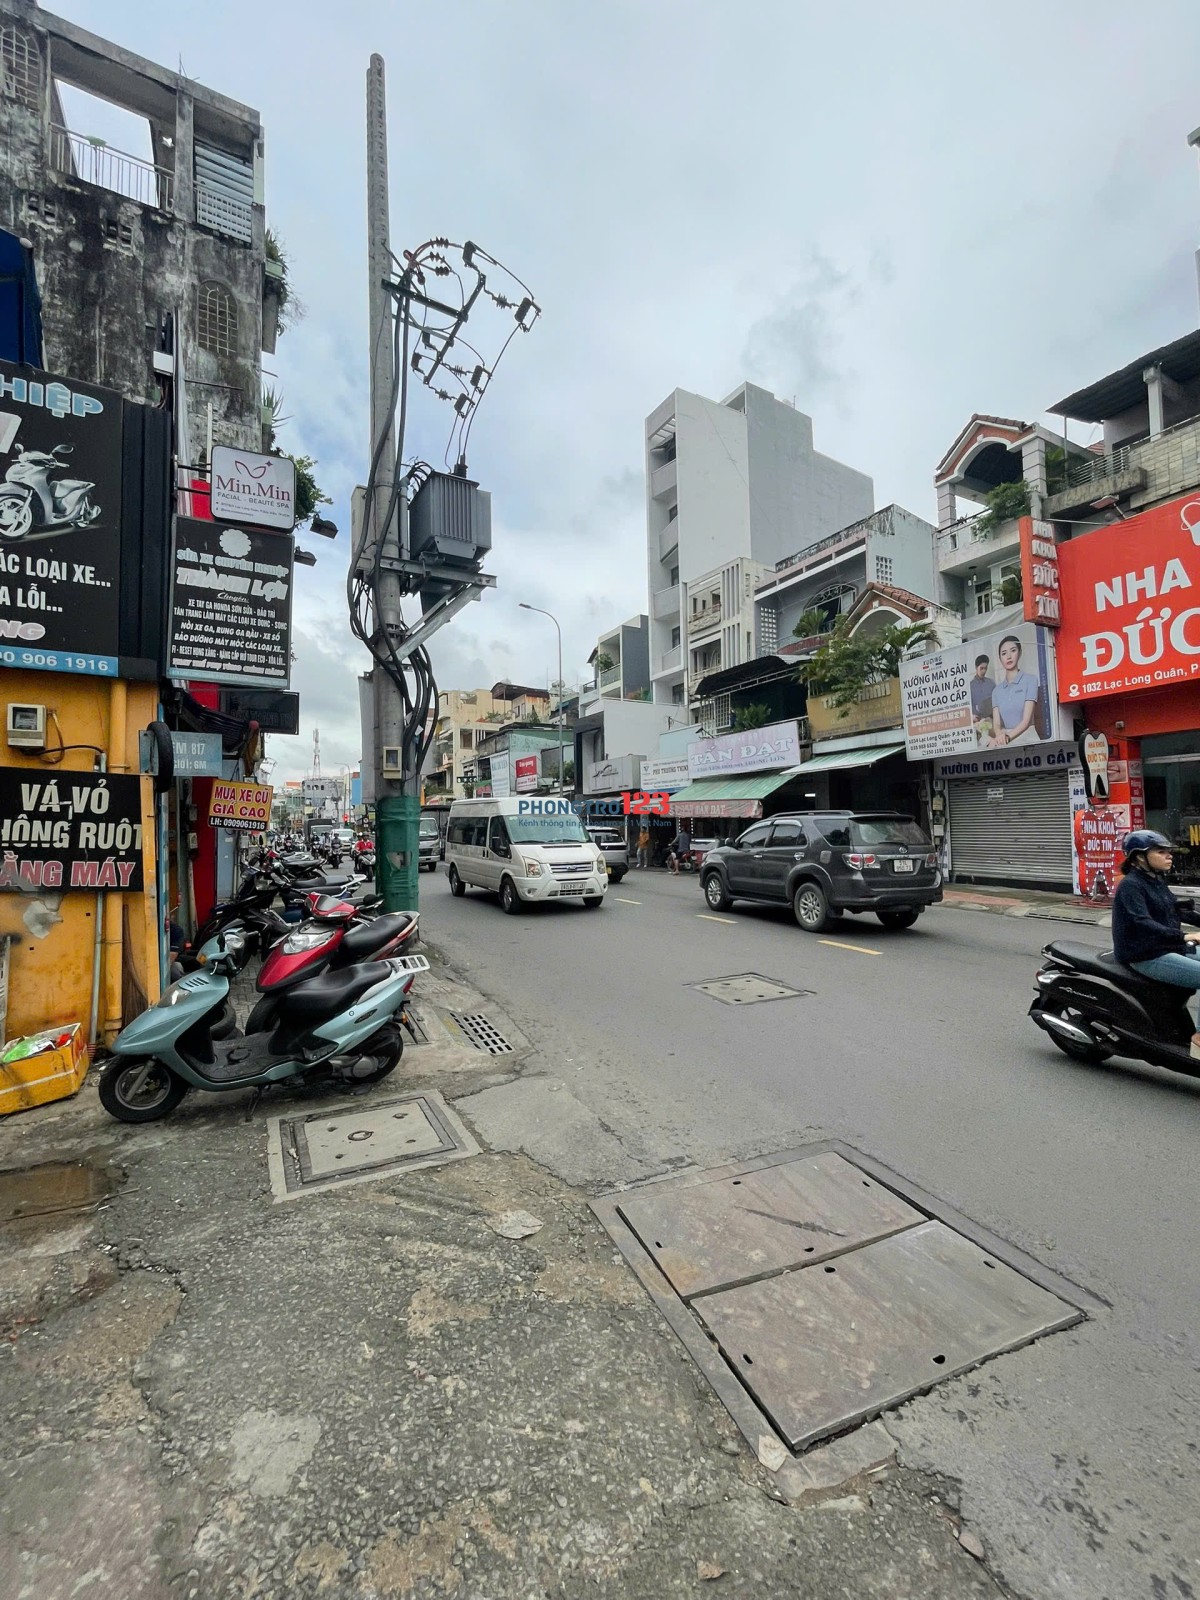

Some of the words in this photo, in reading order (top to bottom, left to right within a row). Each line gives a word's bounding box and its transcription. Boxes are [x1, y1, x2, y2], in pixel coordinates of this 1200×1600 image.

[215, 474, 291, 501] Min.Min
[217, 491, 242, 501] FACIAL
[248, 497, 275, 508] BEAUTÉ
[1032, 520, 1054, 540] NHA
[1031, 540, 1058, 560] KHOA
[25, 556, 67, 584] LOẠI
[72, 563, 111, 587] XE...
[1032, 560, 1059, 590] ĐỨC
[1094, 557, 1193, 613] NHA
[16, 582, 63, 612] LỖI...
[188, 599, 196, 607] XE
[196, 600, 205, 608] TAY
[205, 600, 213, 609] GA
[213, 601, 231, 612] HONDA
[1035, 591, 1059, 619] TÍN
[185, 608, 203, 618] TRANG
[250, 617, 257, 626] XE
[194, 623, 203, 631] XE
[216, 626, 234, 636] RUNG
[235, 629, 245, 637] GA
[262, 632, 271, 640] XE
[214, 636, 230, 646] MÁY
[22, 653, 58, 667] 906
[64, 657, 109, 671] 1916
[903, 674, 930, 689] XƯỞNG
[931, 669, 949, 681] MAY
[950, 663, 968, 676] SẢN
[1082, 681, 1102, 694] 1032
[1103, 679, 1123, 690] Lạc
[1124, 674, 1151, 687] Long
[907, 686, 928, 700] XUẤT
[929, 682, 940, 694] VÀ
[941, 681, 951, 692] IN
[952, 677, 965, 689] ÁO
[907, 699, 930, 711] THUN
[931, 695, 948, 706] CAO
[950, 689, 967, 702] CẤP
[191, 743, 206, 756] 817
[941, 762, 979, 775] XƯỞNG
[982, 759, 1011, 772] MAY
[1014, 755, 1042, 768] CAO
[1046, 749, 1077, 765] CẤP
[21, 779, 61, 812] VÁ
[71, 778, 110, 814] VỎ
[214, 786, 236, 801] MUA
[239, 788, 253, 802] XE
[212, 801, 235, 815] GIÁ
[239, 806, 266, 818] CAO
[210, 817, 222, 826] LH:
[223, 819, 265, 830] 0909061916
[1084, 820, 1097, 834] NHA
[1098, 820, 1115, 835] KHOA
[1087, 836, 1100, 851] ĐỨC
[1101, 836, 1113, 851] TÍN
[70, 856, 136, 887] MÁY
